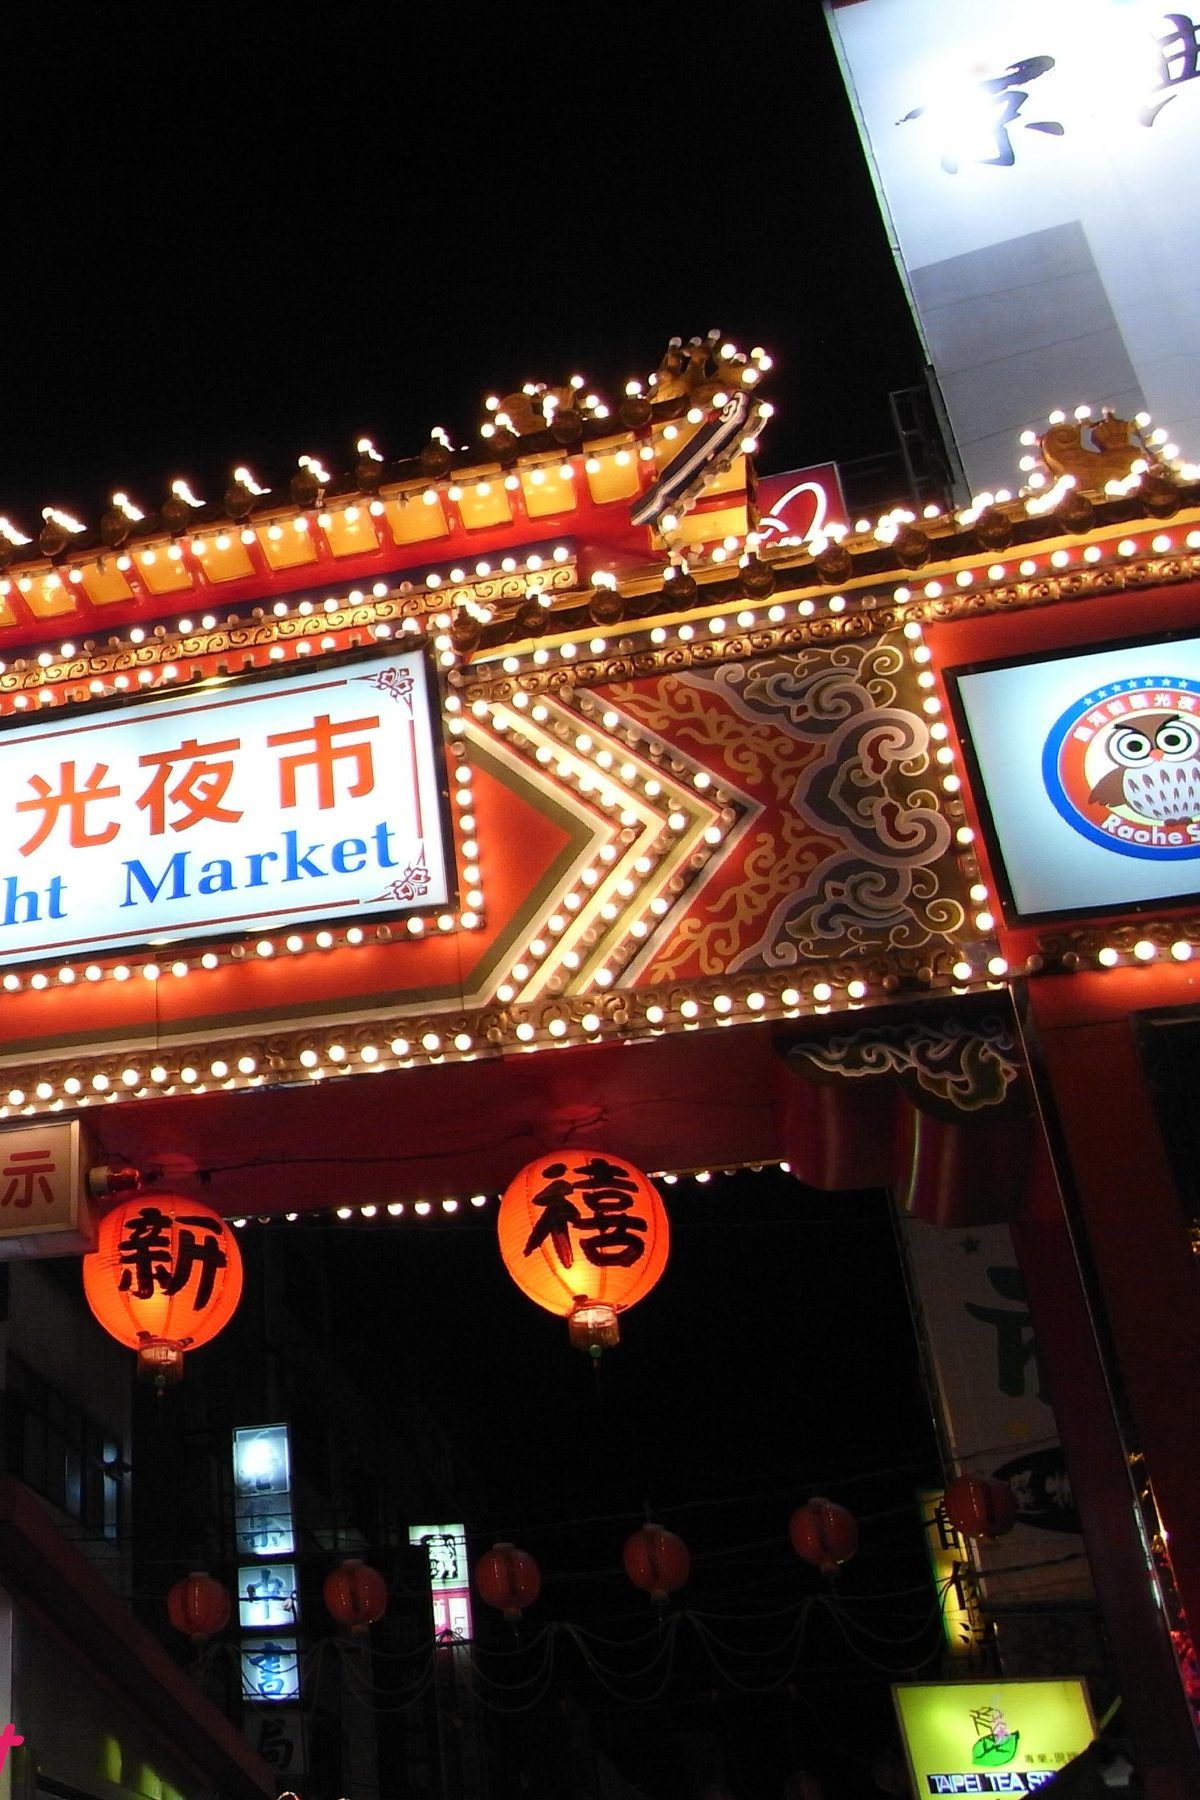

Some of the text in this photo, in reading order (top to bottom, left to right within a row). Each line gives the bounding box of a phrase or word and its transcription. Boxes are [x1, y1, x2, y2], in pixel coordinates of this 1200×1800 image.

[1101, 813, 1183, 846] Raohe
[119, 820, 400, 908] Market
[117, 1207, 228, 1312] 新
[930, 1774, 982, 1794] TAIPEI
[984, 1772, 1025, 1792] TEA
